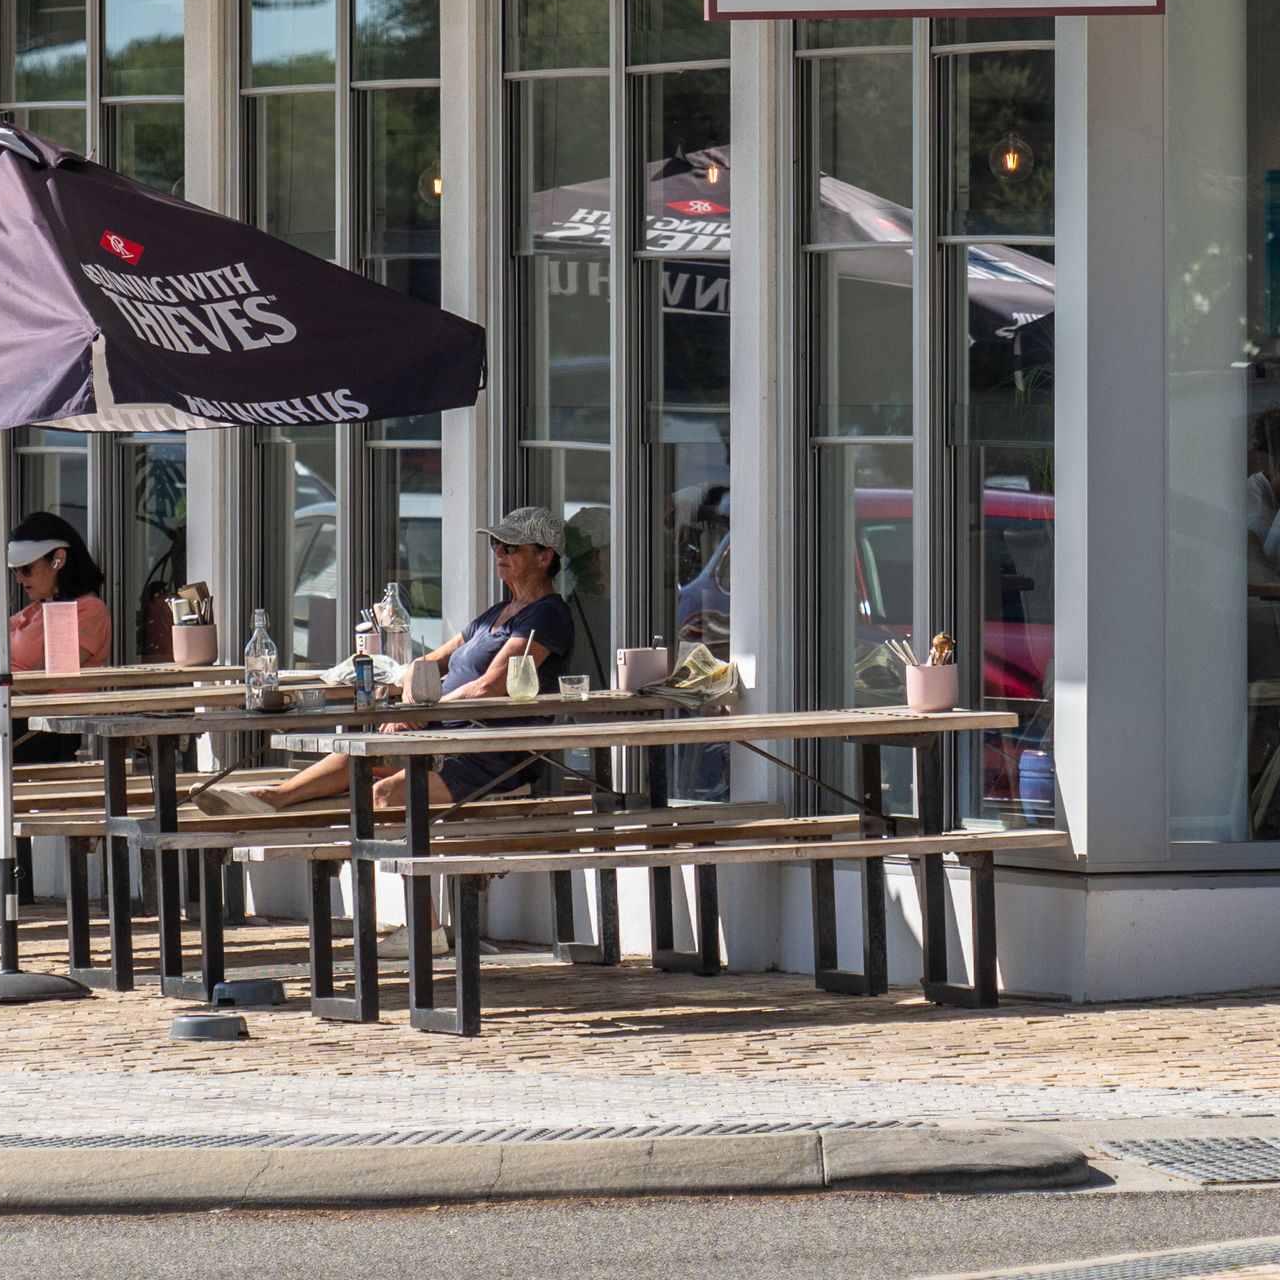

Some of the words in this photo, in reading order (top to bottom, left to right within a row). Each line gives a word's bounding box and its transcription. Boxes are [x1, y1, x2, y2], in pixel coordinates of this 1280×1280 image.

[80, 263, 180, 303] RUNNING
[172, 262, 260, 300] WITH
[100, 287, 297, 355] THIEVES
[220, 398, 324, 424] WITH
[306, 389, 369, 422] US
